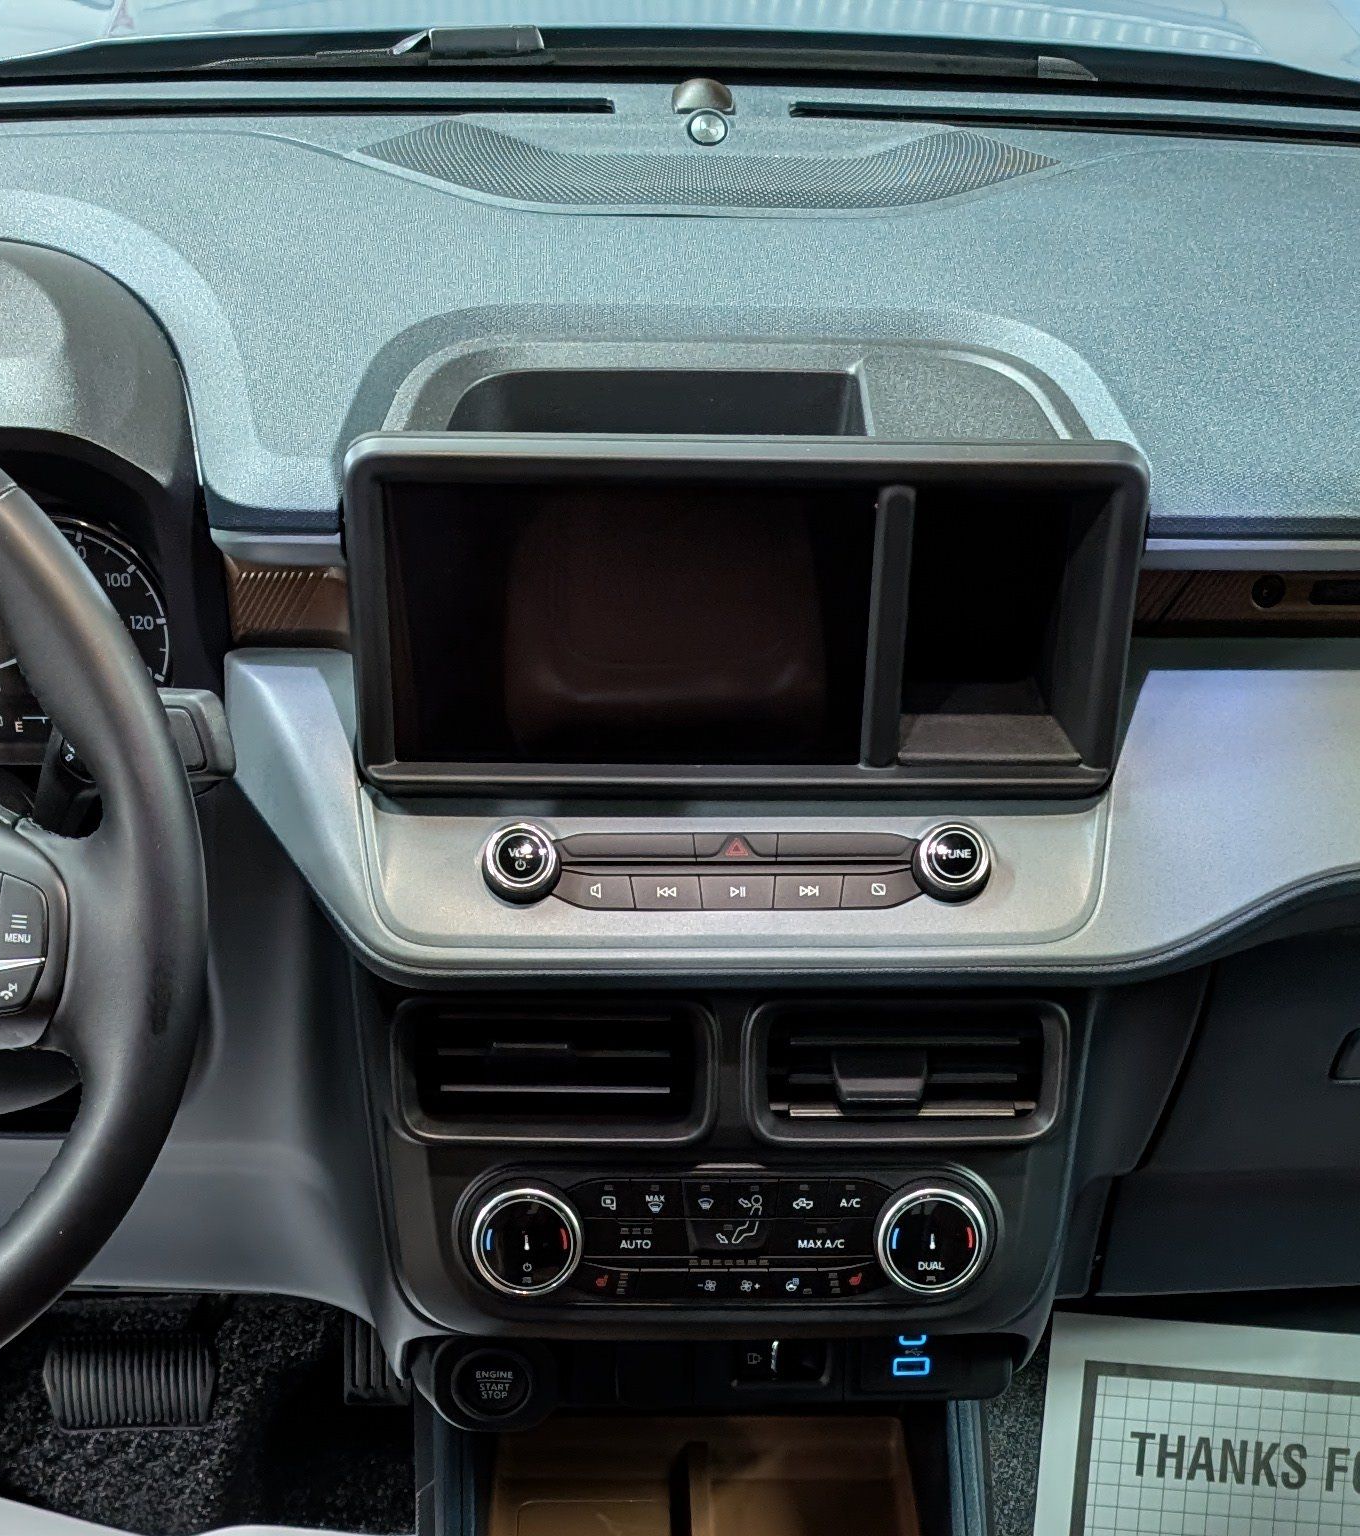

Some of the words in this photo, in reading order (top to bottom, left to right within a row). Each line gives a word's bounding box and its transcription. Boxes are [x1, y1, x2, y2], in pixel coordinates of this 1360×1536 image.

[104, 572, 131, 587] 100
[129, 615, 154, 631] 120
[14, 721, 24, 732] E
[4, 933, 31, 944] MENU
[645, 1195, 666, 1203] MAX
[839, 1198, 861, 1208] A/C
[619, 1239, 652, 1249] AUTO
[797, 1239, 822, 1249] MAX
[824, 1239, 845, 1249] A/C
[917, 1261, 945, 1271] DUAL
[475, 1370, 513, 1379] ENGINE
[479, 1383, 510, 1391] START
[481, 1390, 508, 1399] STOP
[1130, 1431, 1308, 1490] THANKS
